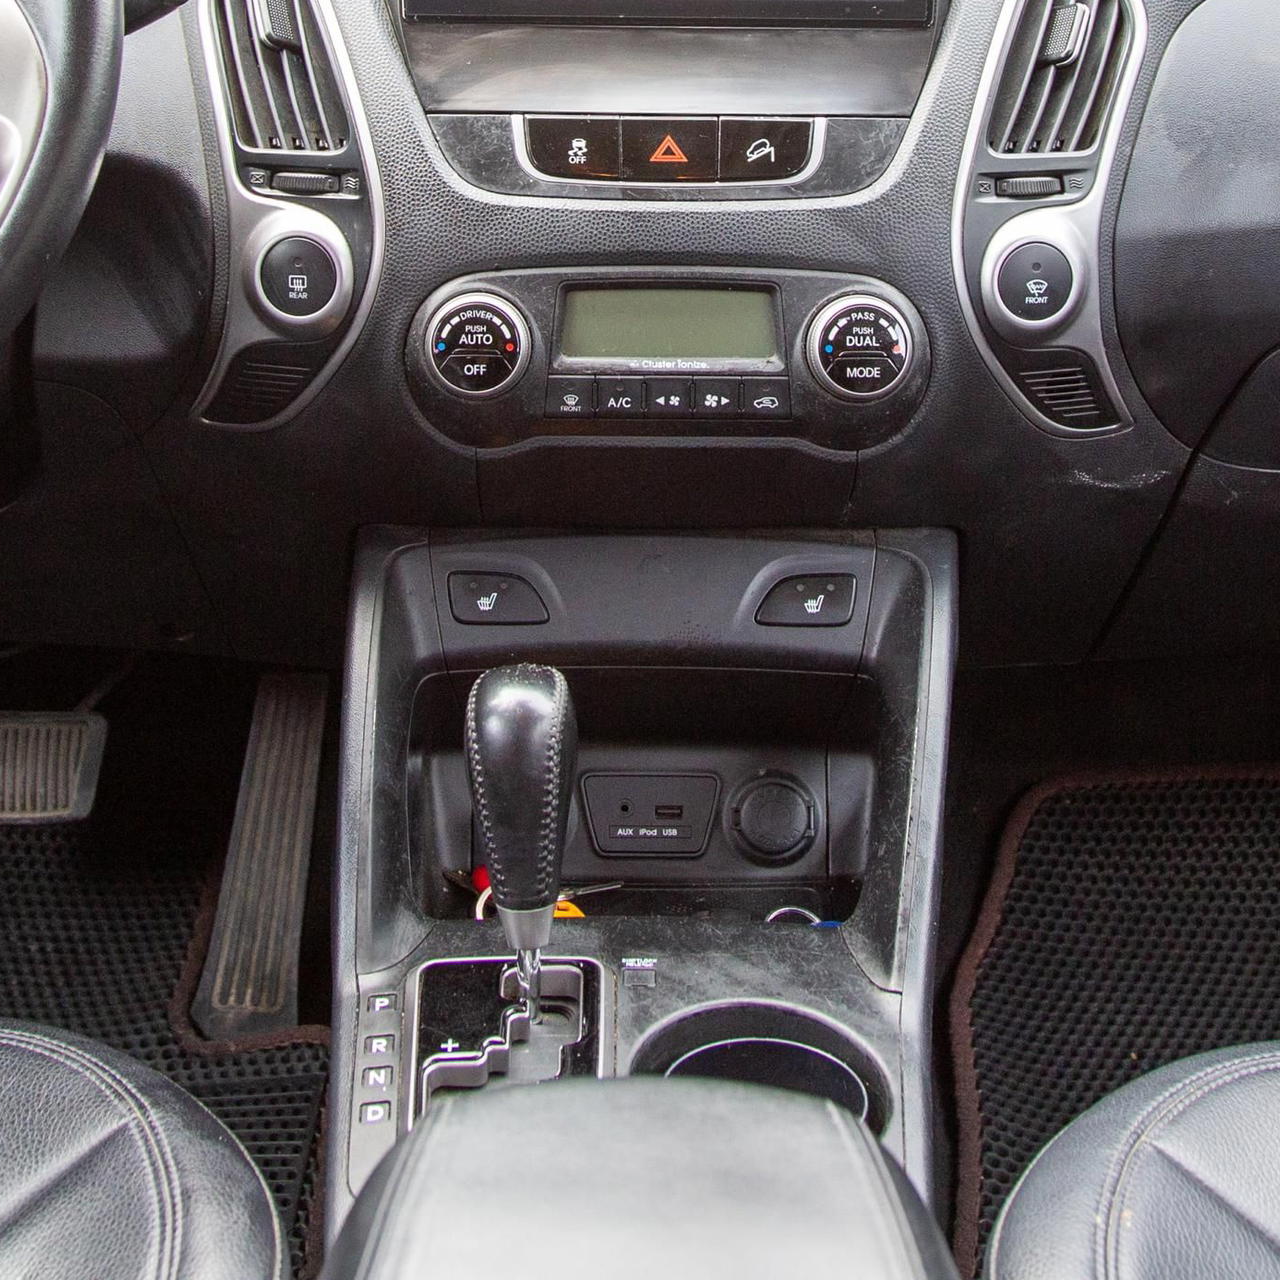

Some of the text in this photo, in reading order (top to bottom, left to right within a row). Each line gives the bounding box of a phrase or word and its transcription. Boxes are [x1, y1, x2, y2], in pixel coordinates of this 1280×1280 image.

[568, 155, 588, 165] OFF
[288, 291, 309, 300] REAR
[1024, 295, 1050, 305] FRONT
[459, 309, 495, 321] DRIVER
[850, 311, 876, 321] PASS
[465, 324, 487, 333] PUSH
[852, 326, 874, 335] PUSH
[458, 333, 493, 346] AUTO
[845, 335, 880, 347] DUAL
[463, 364, 488, 376] OFF
[846, 366, 881, 379] MODE
[607, 396, 632, 409] A/C
[617, 827, 678, 837] AUX iPod USB
[374, 997, 390, 1012] P
[371, 1038, 388, 1053] R
[368, 1069, 386, 1086] N
[366, 1104, 385, 1122] D
